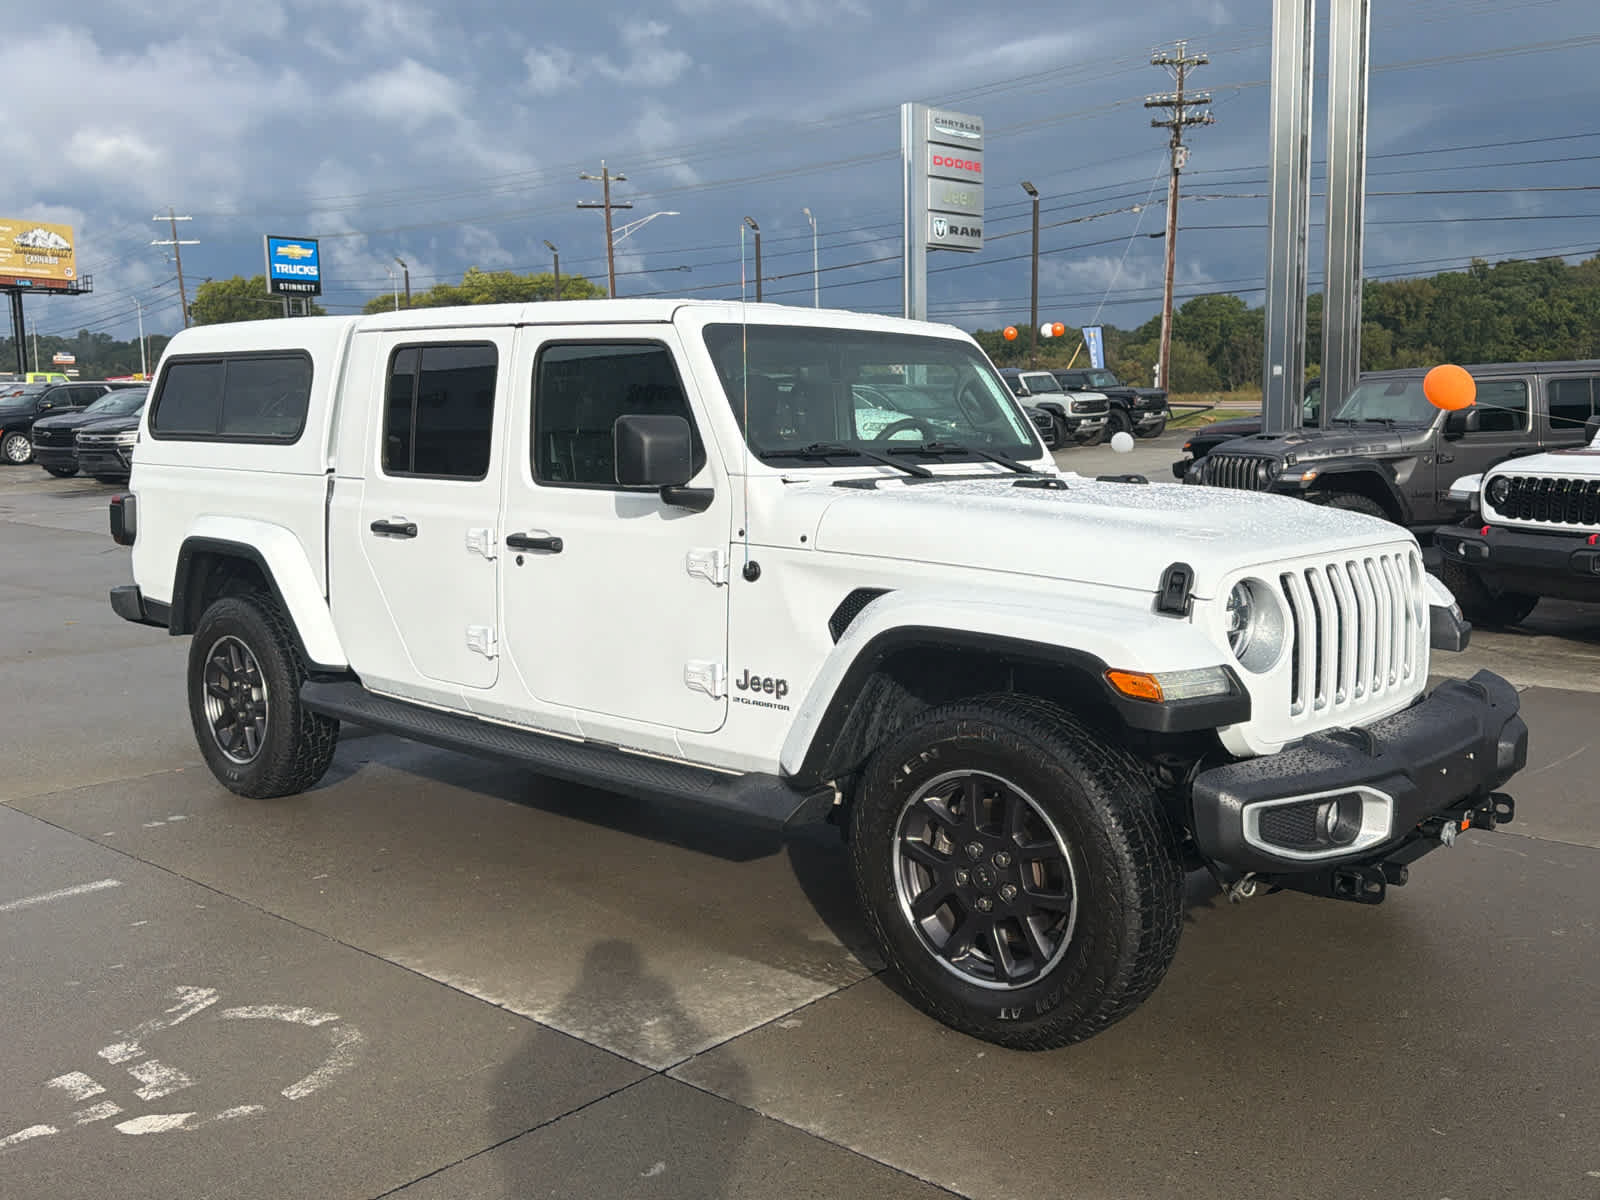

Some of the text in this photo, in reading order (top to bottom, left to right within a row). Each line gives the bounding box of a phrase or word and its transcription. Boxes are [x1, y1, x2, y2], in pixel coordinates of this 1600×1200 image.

[934, 117, 981, 131] CHRYSLER
[932, 155, 982, 173] DODGE
[949, 225, 981, 238] RAM
[274, 263, 318, 276] TRUCKS
[279, 282, 315, 292] STINNETT
[736, 669, 788, 700] Jeep
